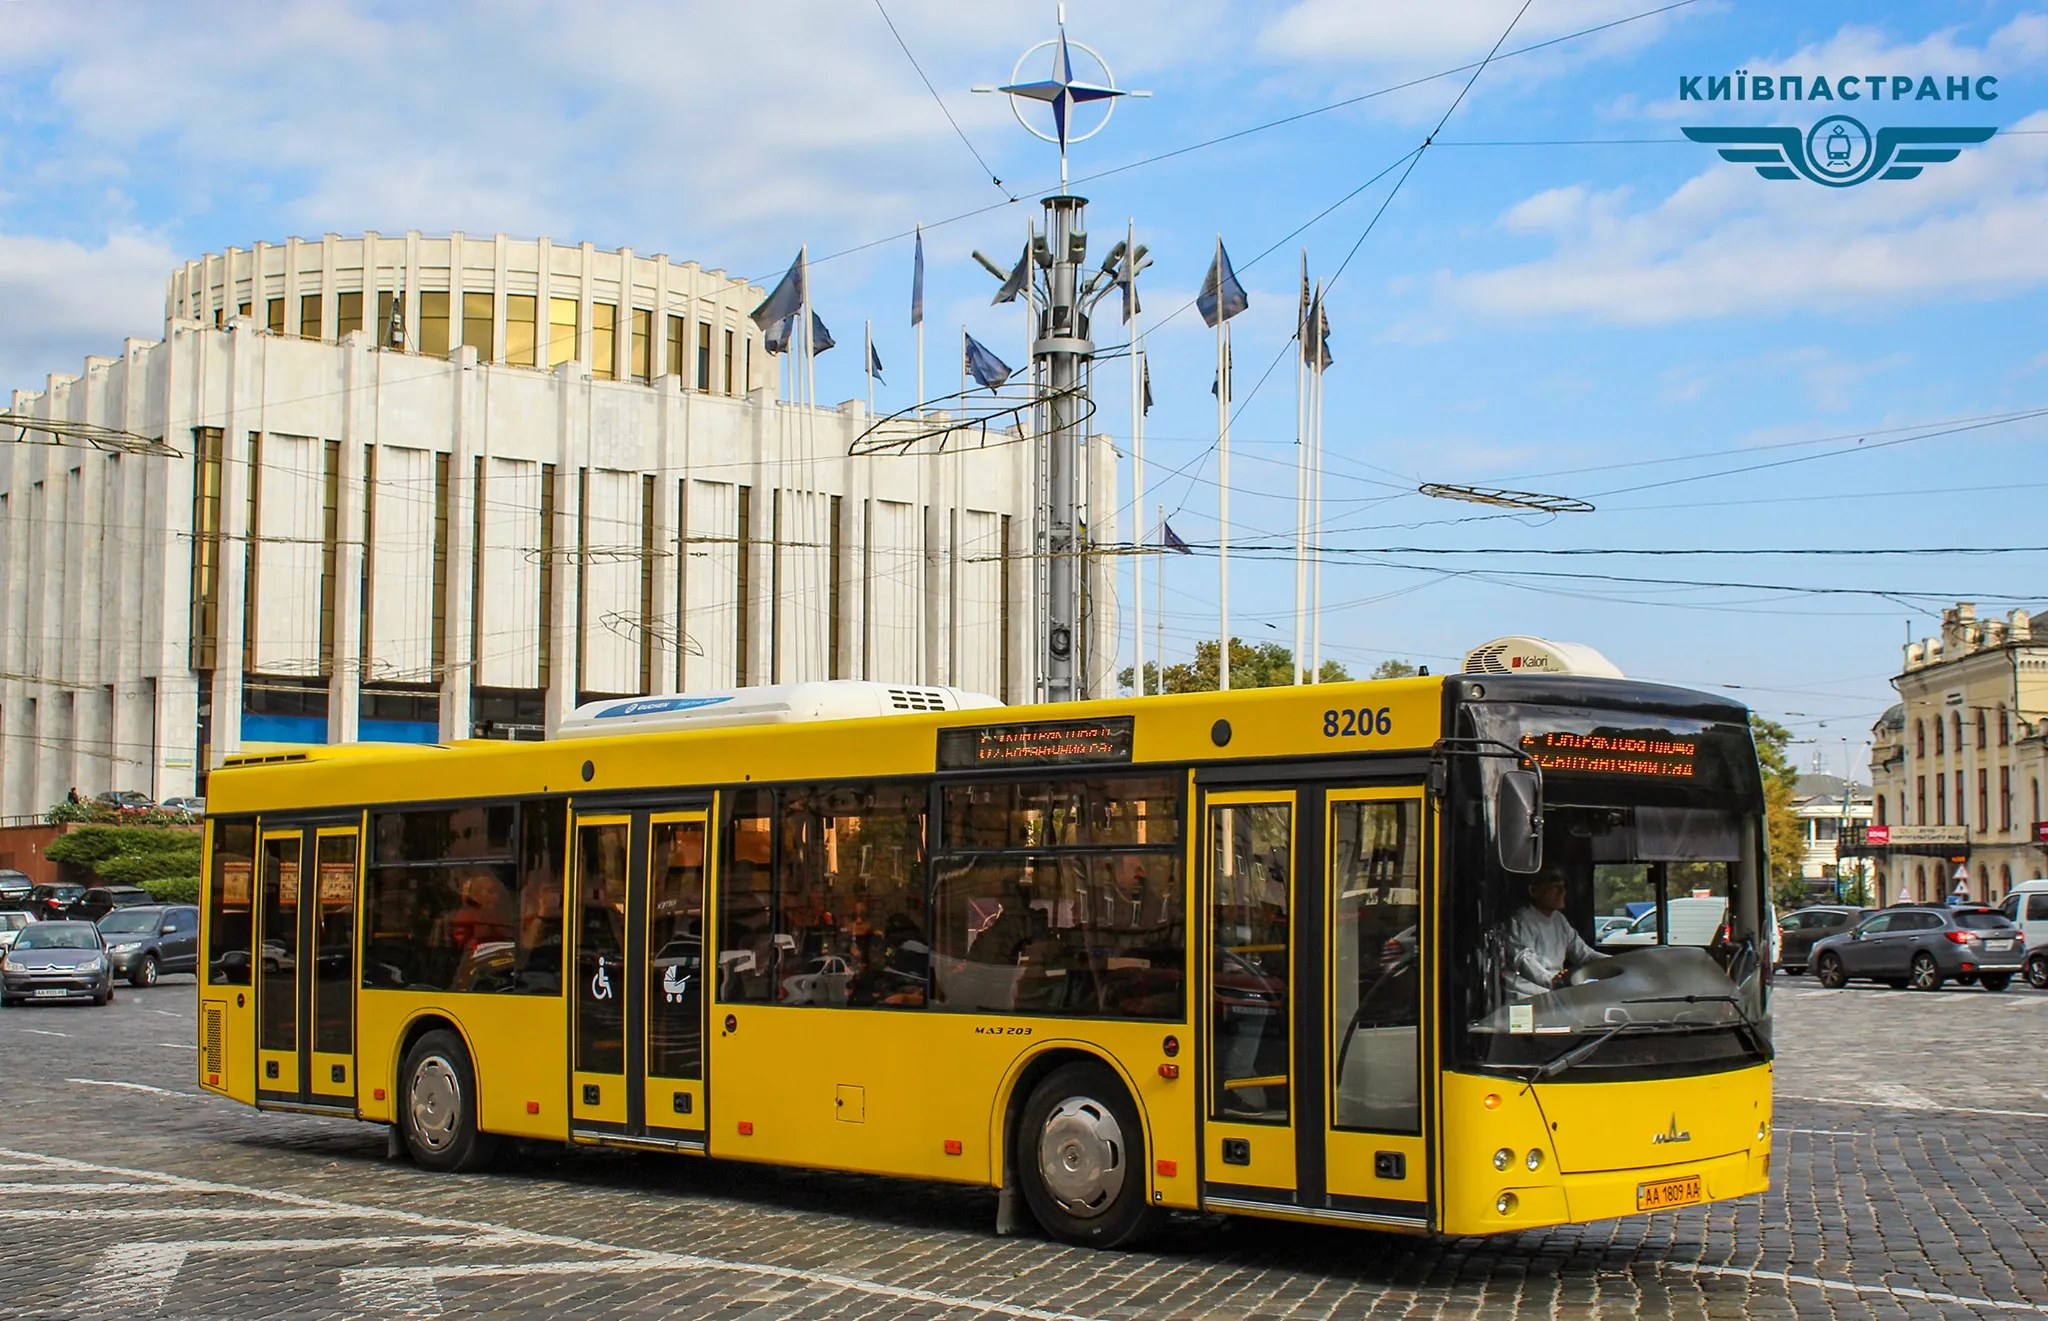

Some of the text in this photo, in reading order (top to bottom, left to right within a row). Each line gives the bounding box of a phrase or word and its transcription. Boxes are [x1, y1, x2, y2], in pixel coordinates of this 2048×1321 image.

[1522, 654, 1548, 668] Kalori
[1323, 707, 1391, 737] 8206
[975, 1027, 1033, 1036] МАЗ 203
[1646, 1182, 1700, 1206] AA 1809 AA
